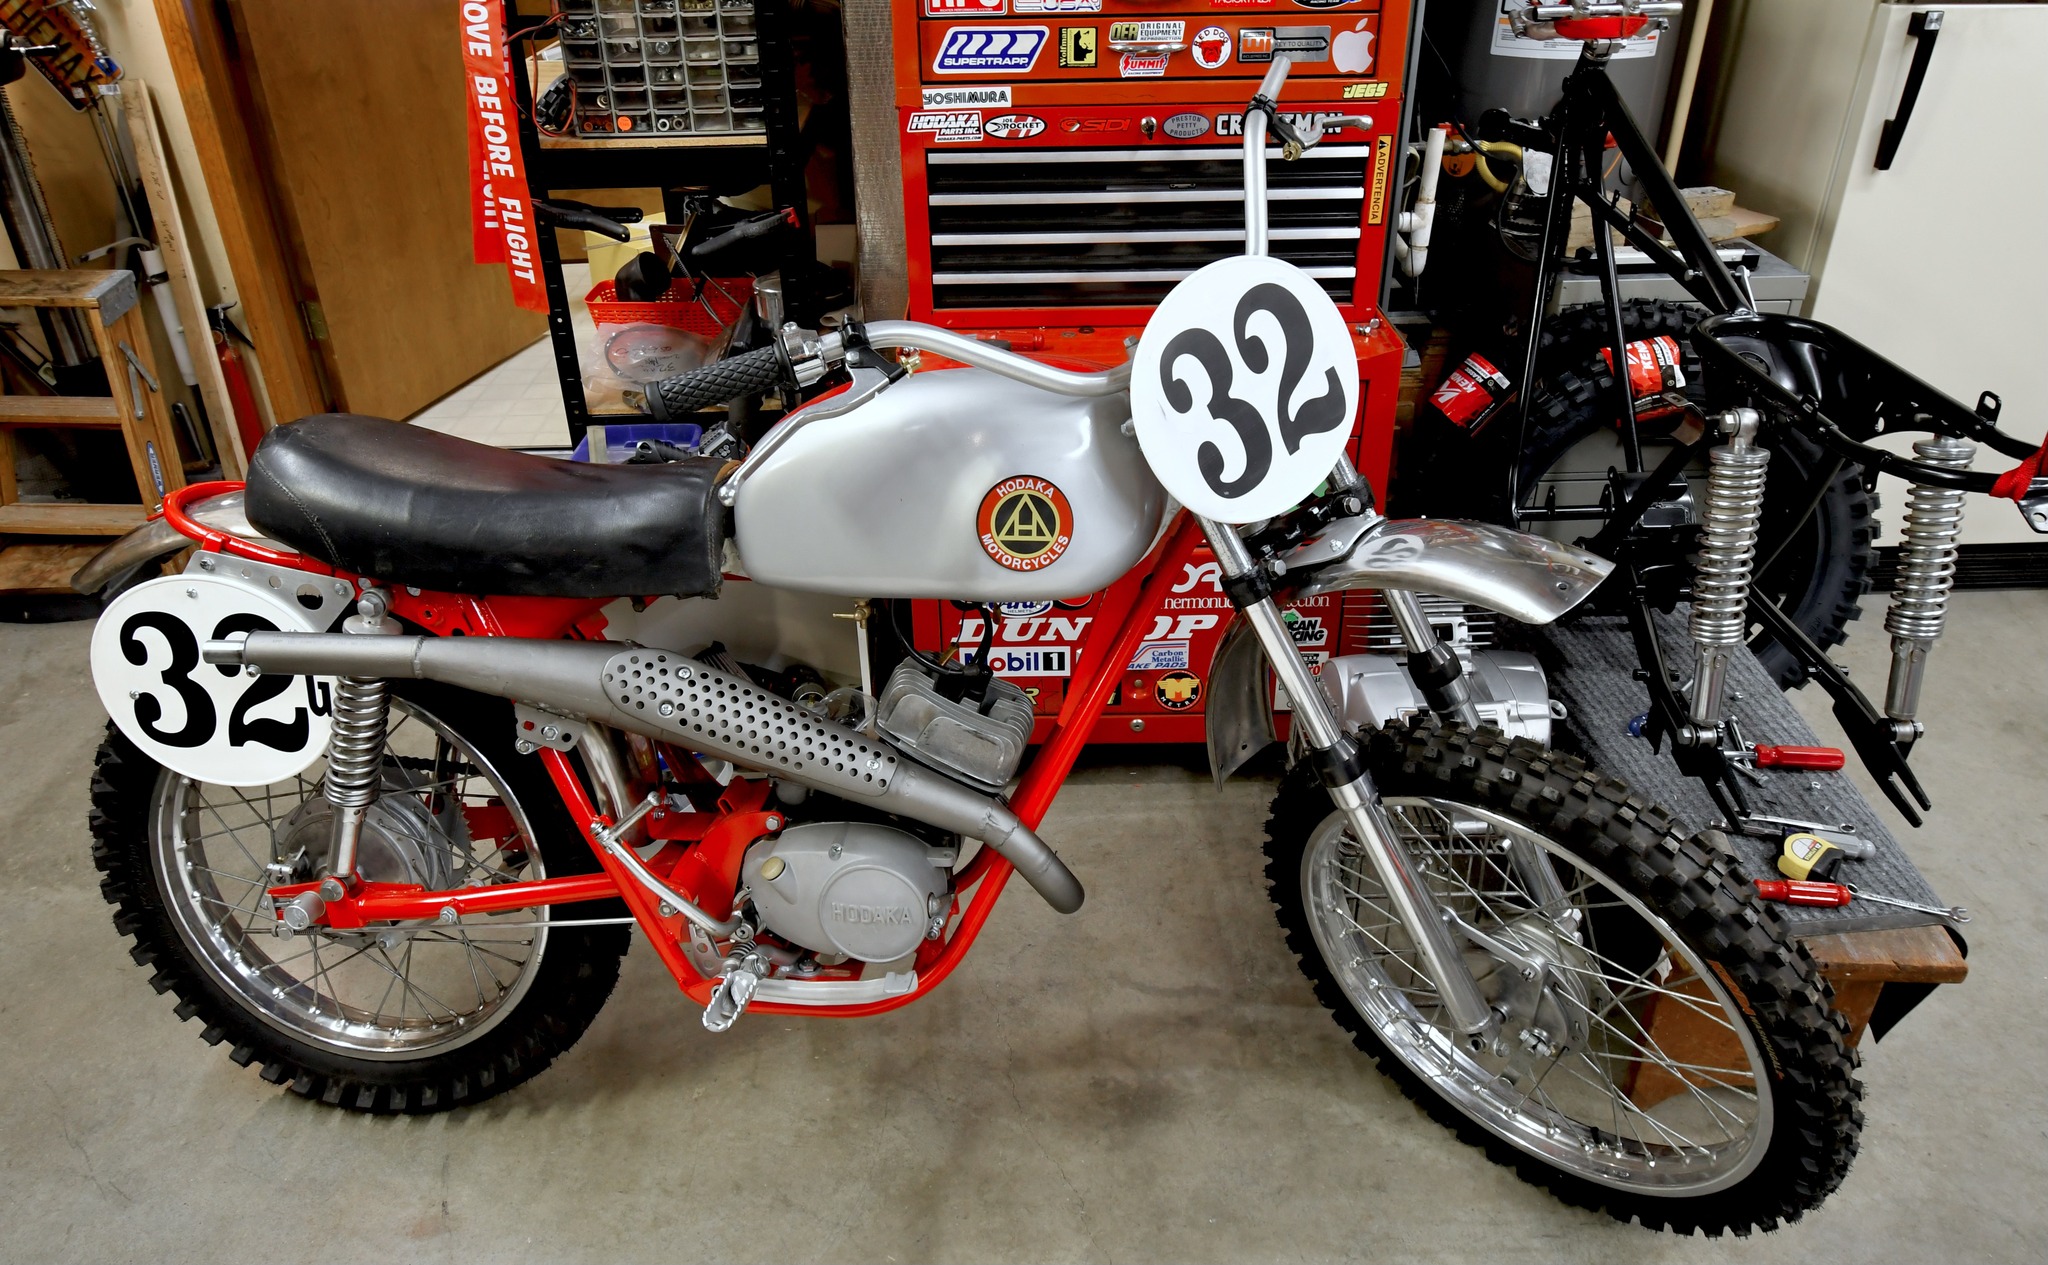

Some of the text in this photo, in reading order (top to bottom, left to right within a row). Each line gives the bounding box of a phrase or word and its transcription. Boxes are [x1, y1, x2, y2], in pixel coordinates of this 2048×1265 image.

[463, 0, 493, 57] OVE
[1111, 23, 1139, 41] OER
[1140, 22, 1182, 30] ORIGINAL
[1193, 29, 1229, 48] RED DOG
[943, 57, 1027, 66] SUPERTRAPP
[922, 90, 1009, 106] YOSHIMURA
[1343, 83, 1388, 99] JEGS
[474, 75, 515, 178] BEFORE
[911, 114, 980, 129] HODAKA
[1004, 122, 1041, 130] ROCKET
[1171, 115, 1202, 124] PRESTON
[1169, 127, 1204, 136] PRODUCTS
[1371, 151, 1386, 220] ADVERTENCIA
[499, 196, 536, 285] FLIGHT
[1160, 283, 1346, 499] 32
[996, 478, 1055, 499] HODAKA
[981, 533, 1069, 570] MOTORCYCLES
[1049, 652, 1059, 670] 1
[120, 611, 310, 753] 32
[1160, 694, 1197, 708] METRO
[831, 902, 913, 925] HODAKA
